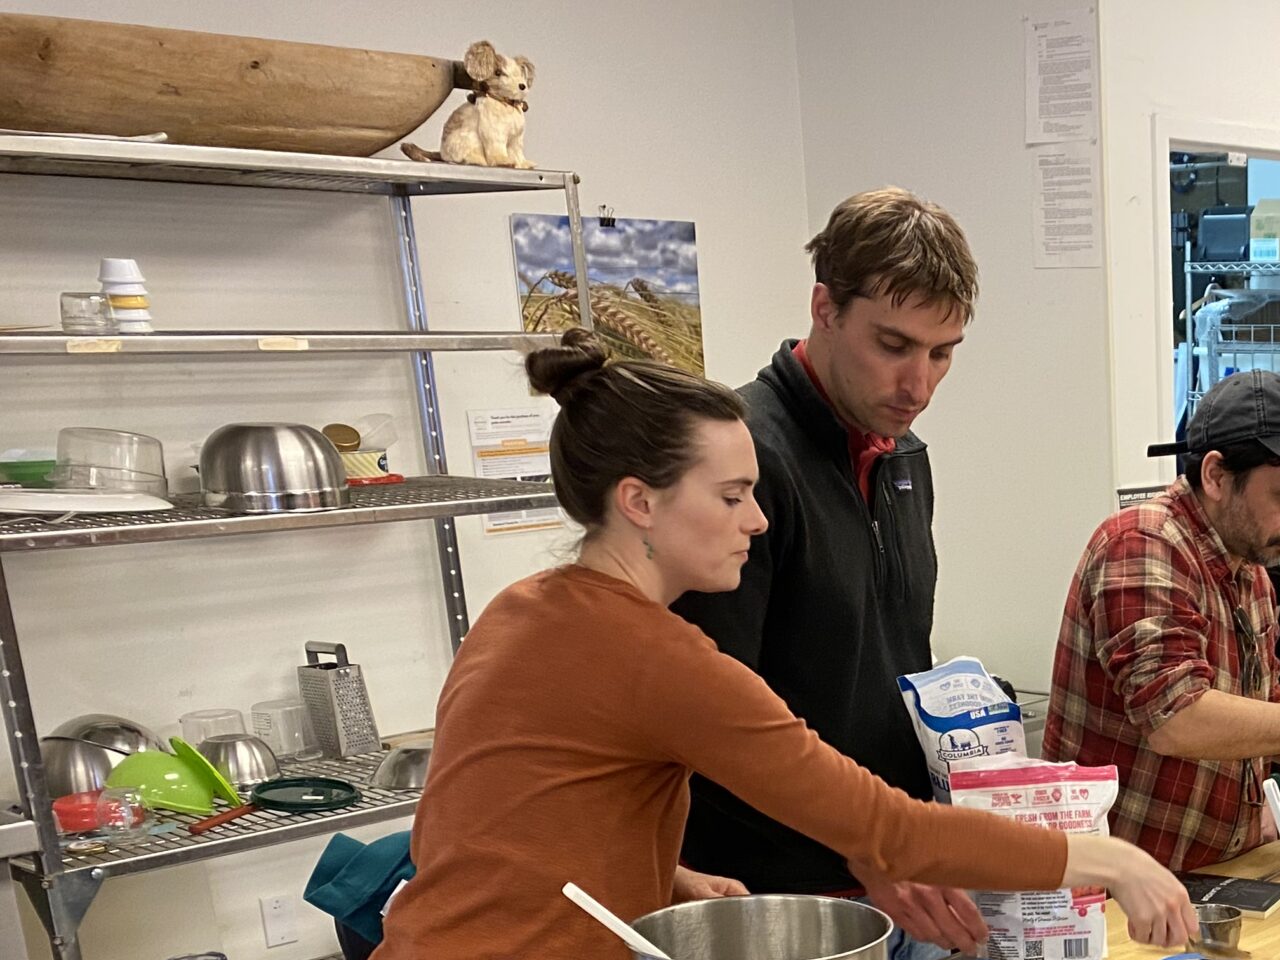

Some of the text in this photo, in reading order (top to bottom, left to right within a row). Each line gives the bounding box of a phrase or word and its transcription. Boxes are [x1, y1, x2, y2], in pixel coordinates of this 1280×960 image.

[970, 709, 986, 719] USA
[942, 749, 982, 759] COLUMBIA
[1060, 810, 1073, 819] THE
[1059, 820, 1092, 830] GOODNESS
